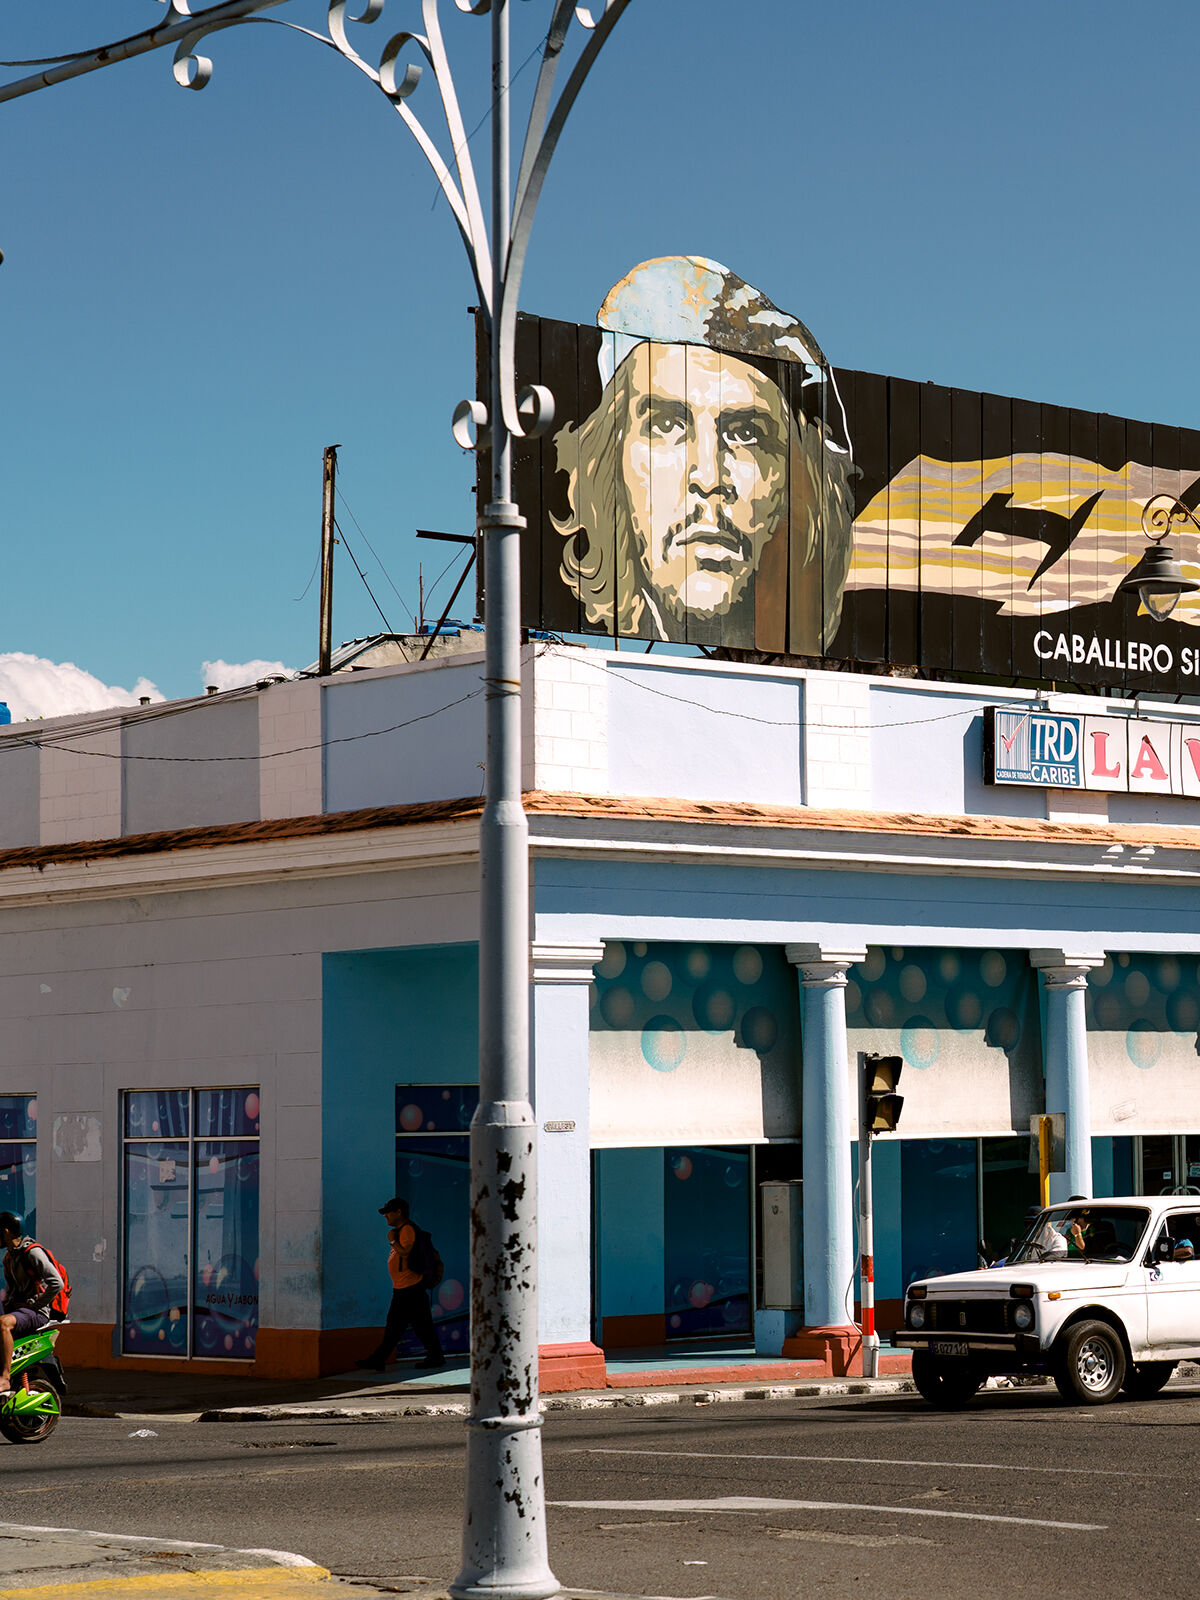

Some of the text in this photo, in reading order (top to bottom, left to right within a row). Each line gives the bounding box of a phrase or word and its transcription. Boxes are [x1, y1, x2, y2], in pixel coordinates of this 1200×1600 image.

[1033, 630, 1174, 674] CABALLERO
[1031, 718, 1078, 762] TRD
[1090, 731, 1168, 780] LA
[1031, 765, 1077, 785] CARIBE
[227, 1292, 234, 1308] Y
